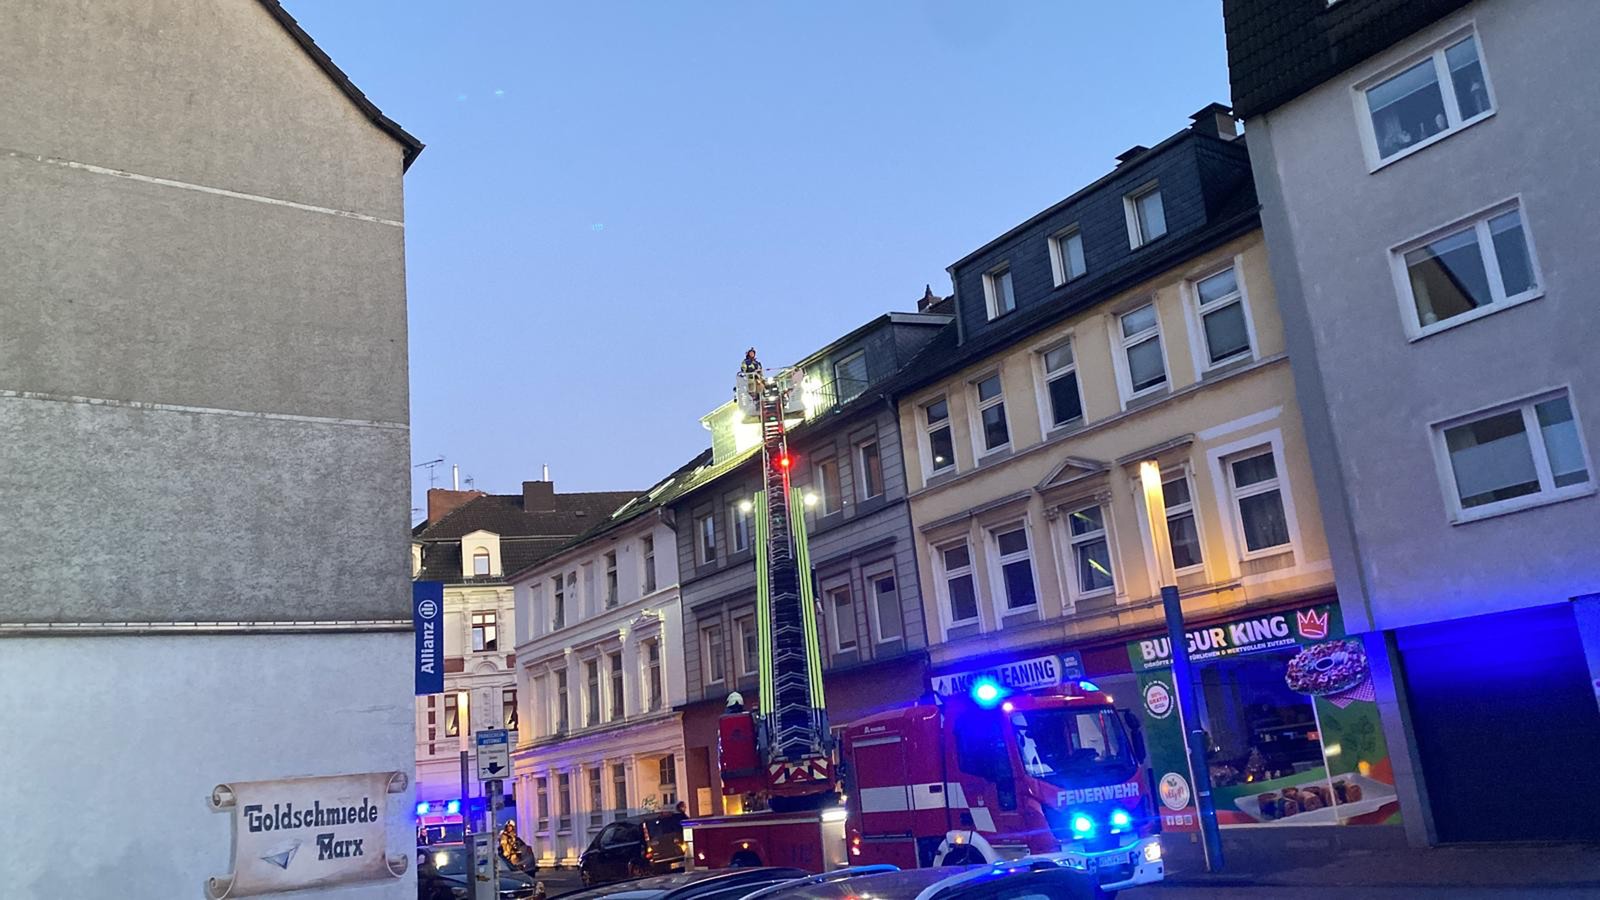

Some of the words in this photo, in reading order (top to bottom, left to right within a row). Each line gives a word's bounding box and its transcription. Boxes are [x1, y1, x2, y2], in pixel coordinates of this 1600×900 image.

[421, 622, 434, 674] Allianz
[1140, 628, 1227, 660] BUGUR
[1229, 616, 1289, 646] KING
[1057, 782, 1139, 807] FEUERWEHR
[244, 797, 378, 832] Goldschmiede
[316, 832, 364, 860] Marx
